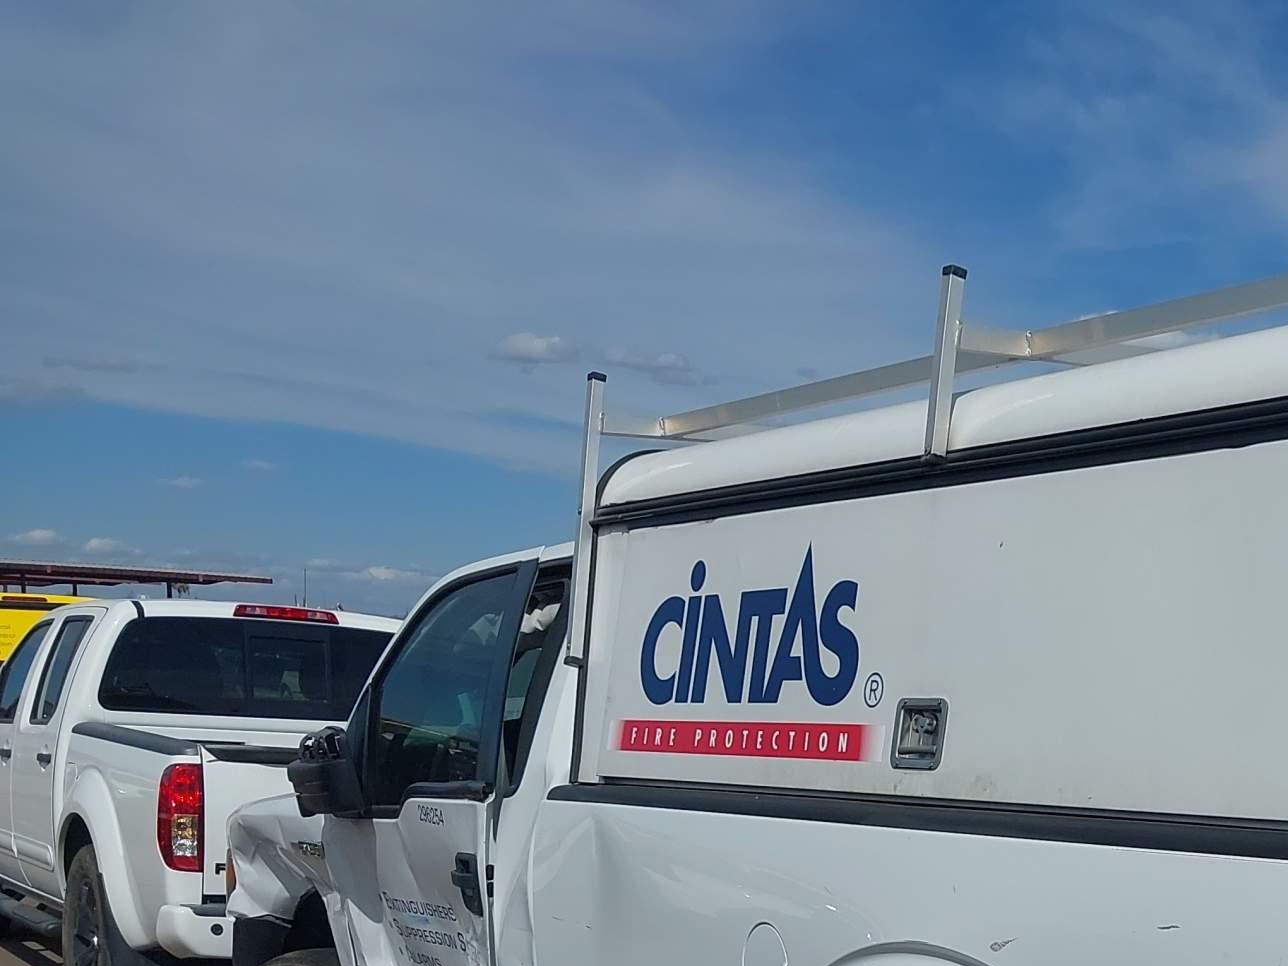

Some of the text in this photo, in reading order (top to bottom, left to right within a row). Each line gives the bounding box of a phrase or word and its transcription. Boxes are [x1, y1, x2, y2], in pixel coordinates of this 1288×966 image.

[631, 727, 849, 753] FIRE PROTECTION
[417, 804, 445, 828] 296254
